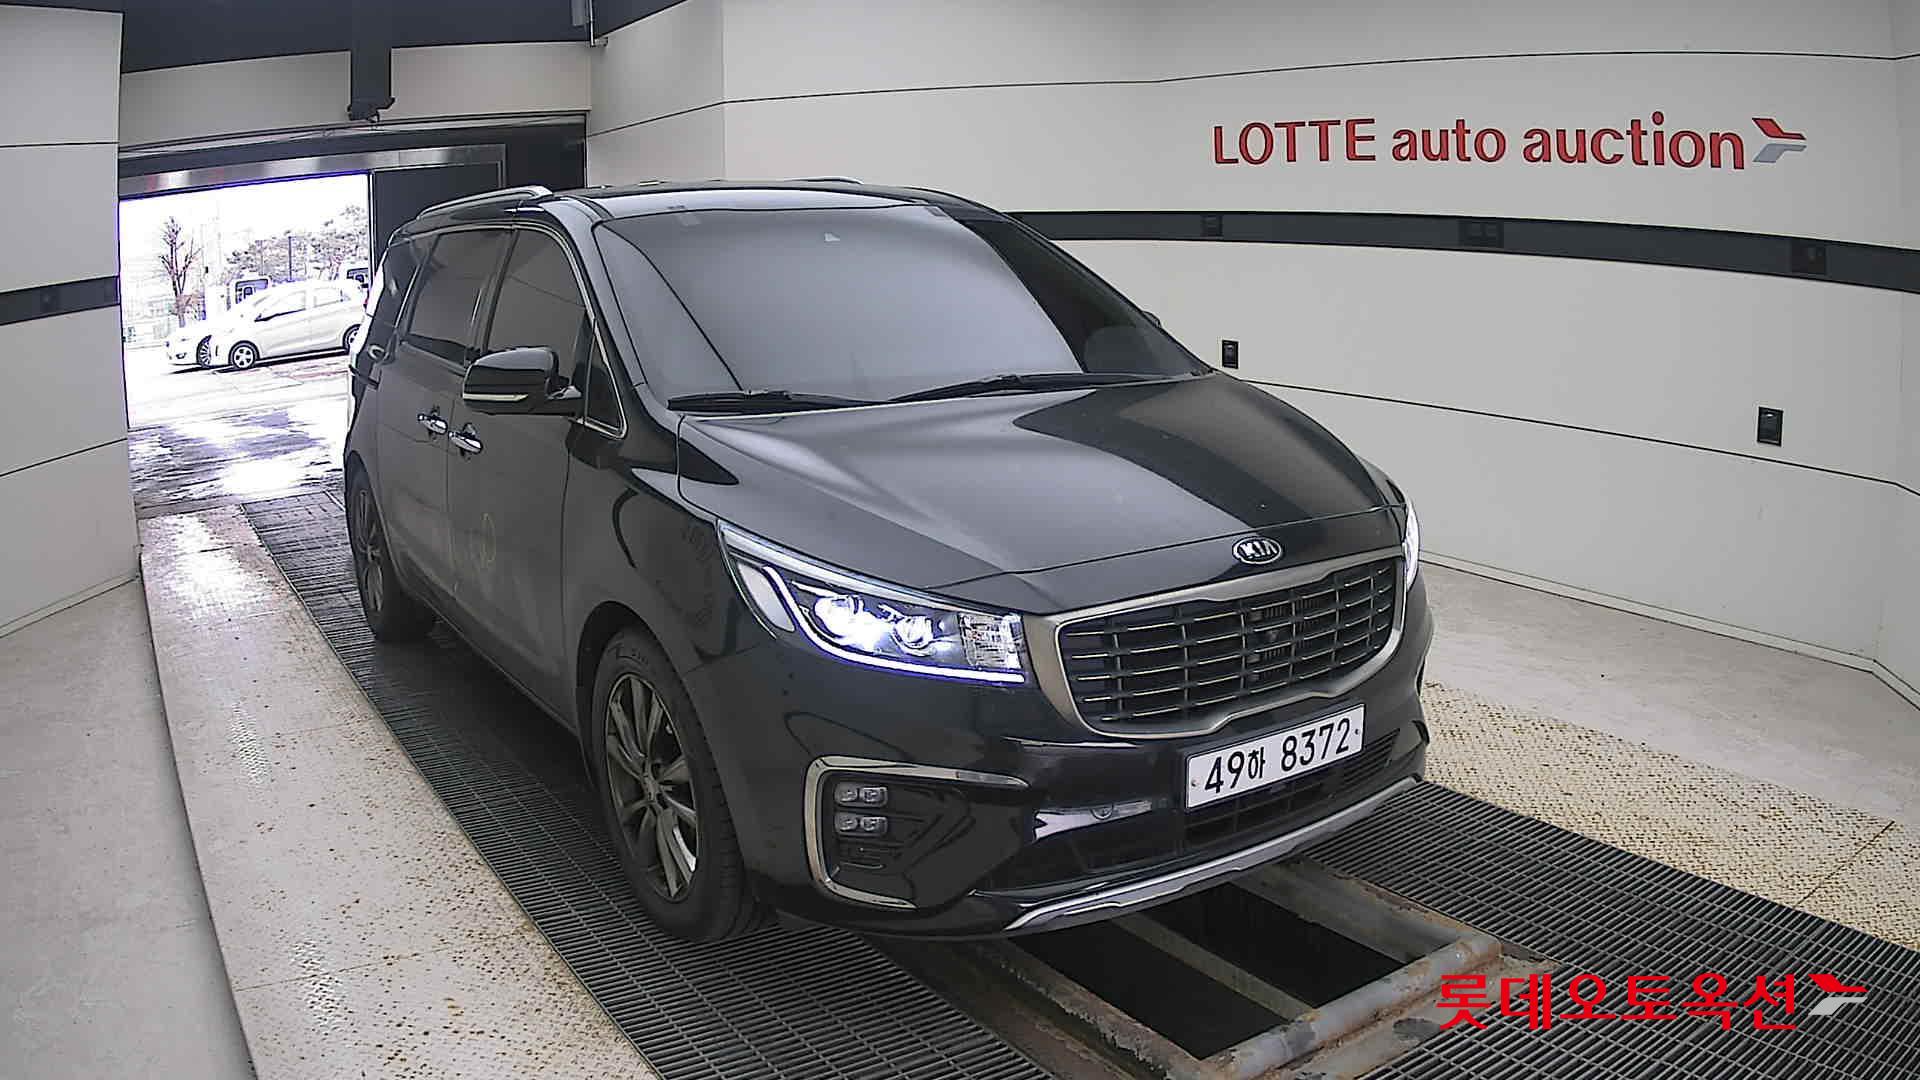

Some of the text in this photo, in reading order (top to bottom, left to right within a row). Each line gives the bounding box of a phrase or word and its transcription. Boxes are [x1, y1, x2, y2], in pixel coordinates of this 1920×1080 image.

[1213, 111, 1746, 171] LOTTE auto auction
[1239, 539, 1279, 560] KIA
[1204, 717, 1351, 794] 49하 8372
